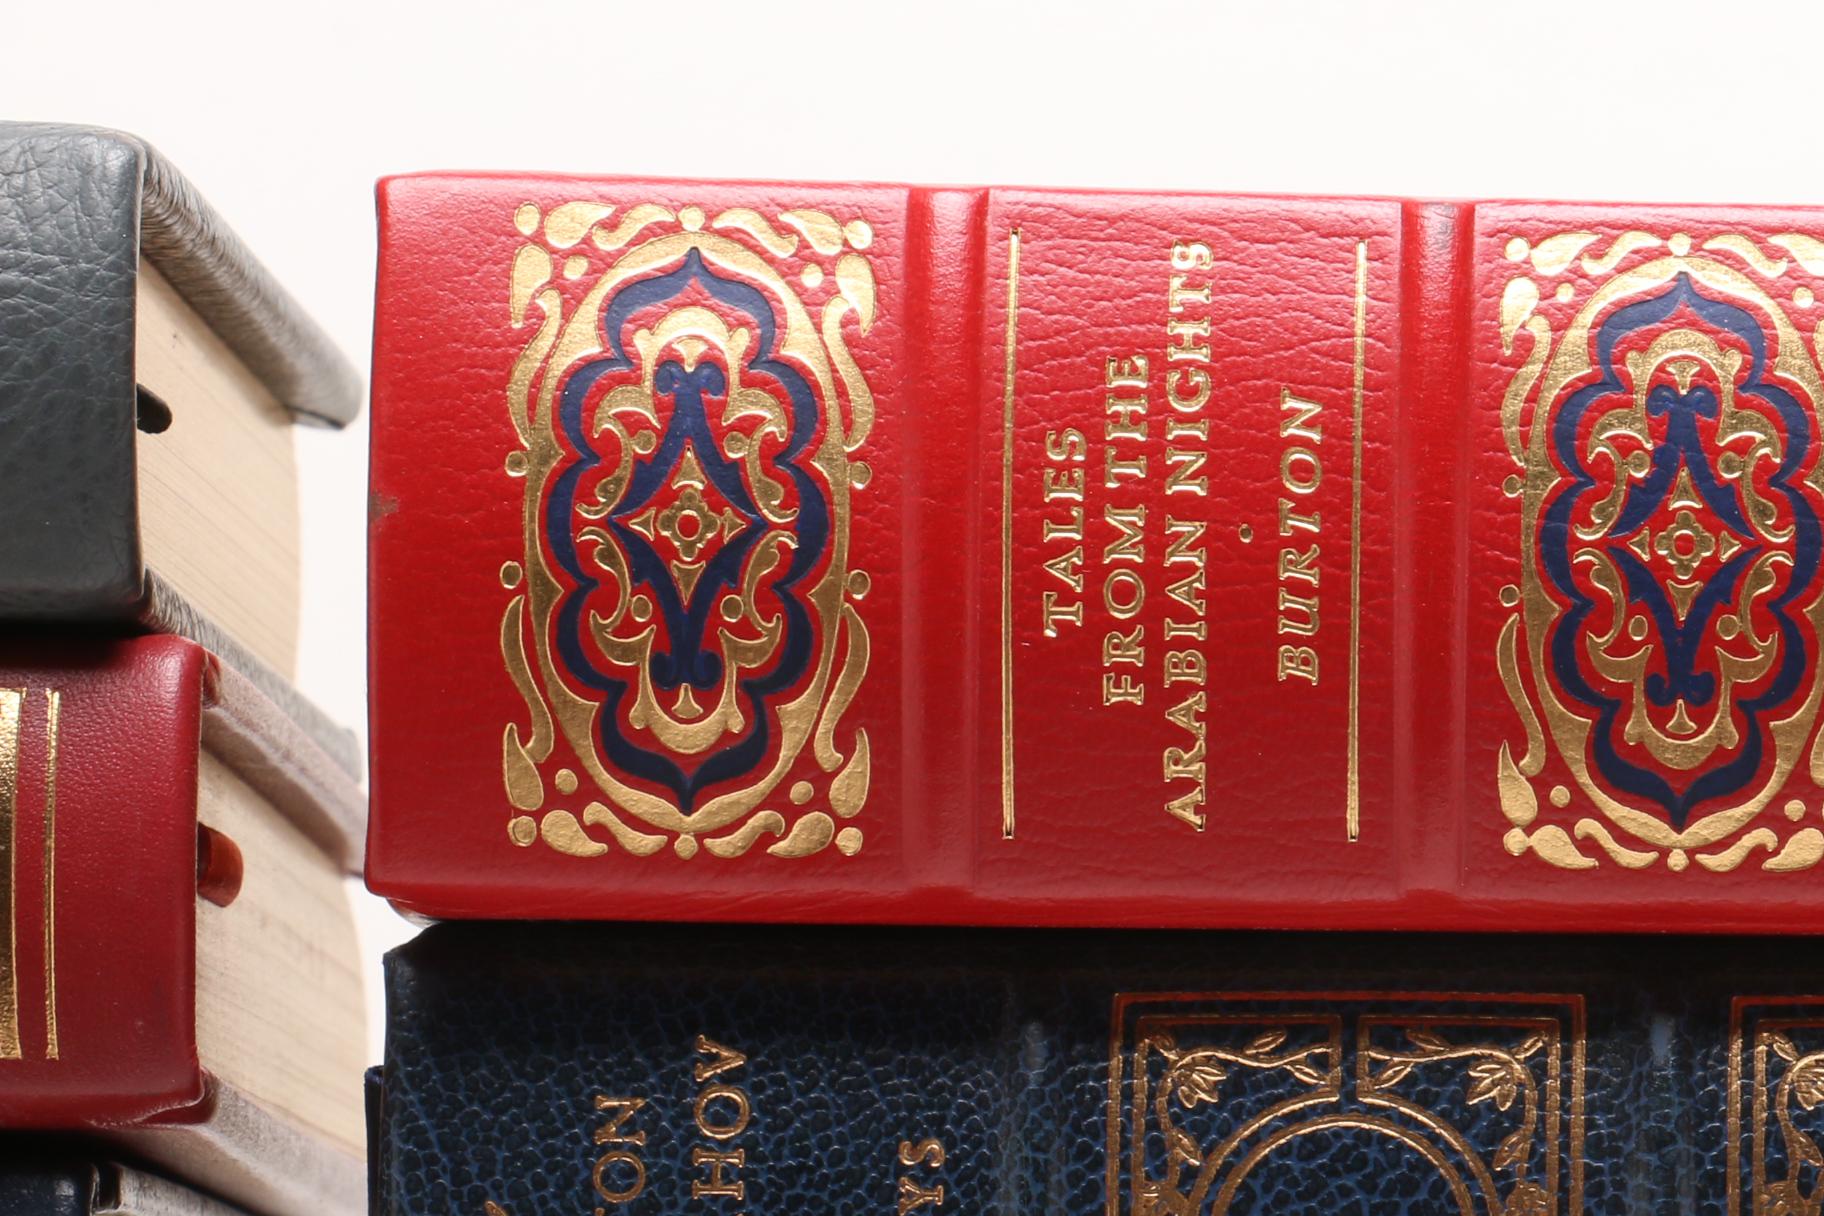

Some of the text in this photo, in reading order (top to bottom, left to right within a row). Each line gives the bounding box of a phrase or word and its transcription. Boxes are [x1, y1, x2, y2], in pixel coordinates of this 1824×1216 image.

[1043, 427, 1087, 638] TALES
[1102, 353, 1150, 708] FROM THE
[1163, 238, 1214, 834] ARABIAN NIGHTS
[1277, 386, 1324, 686] BURTON
